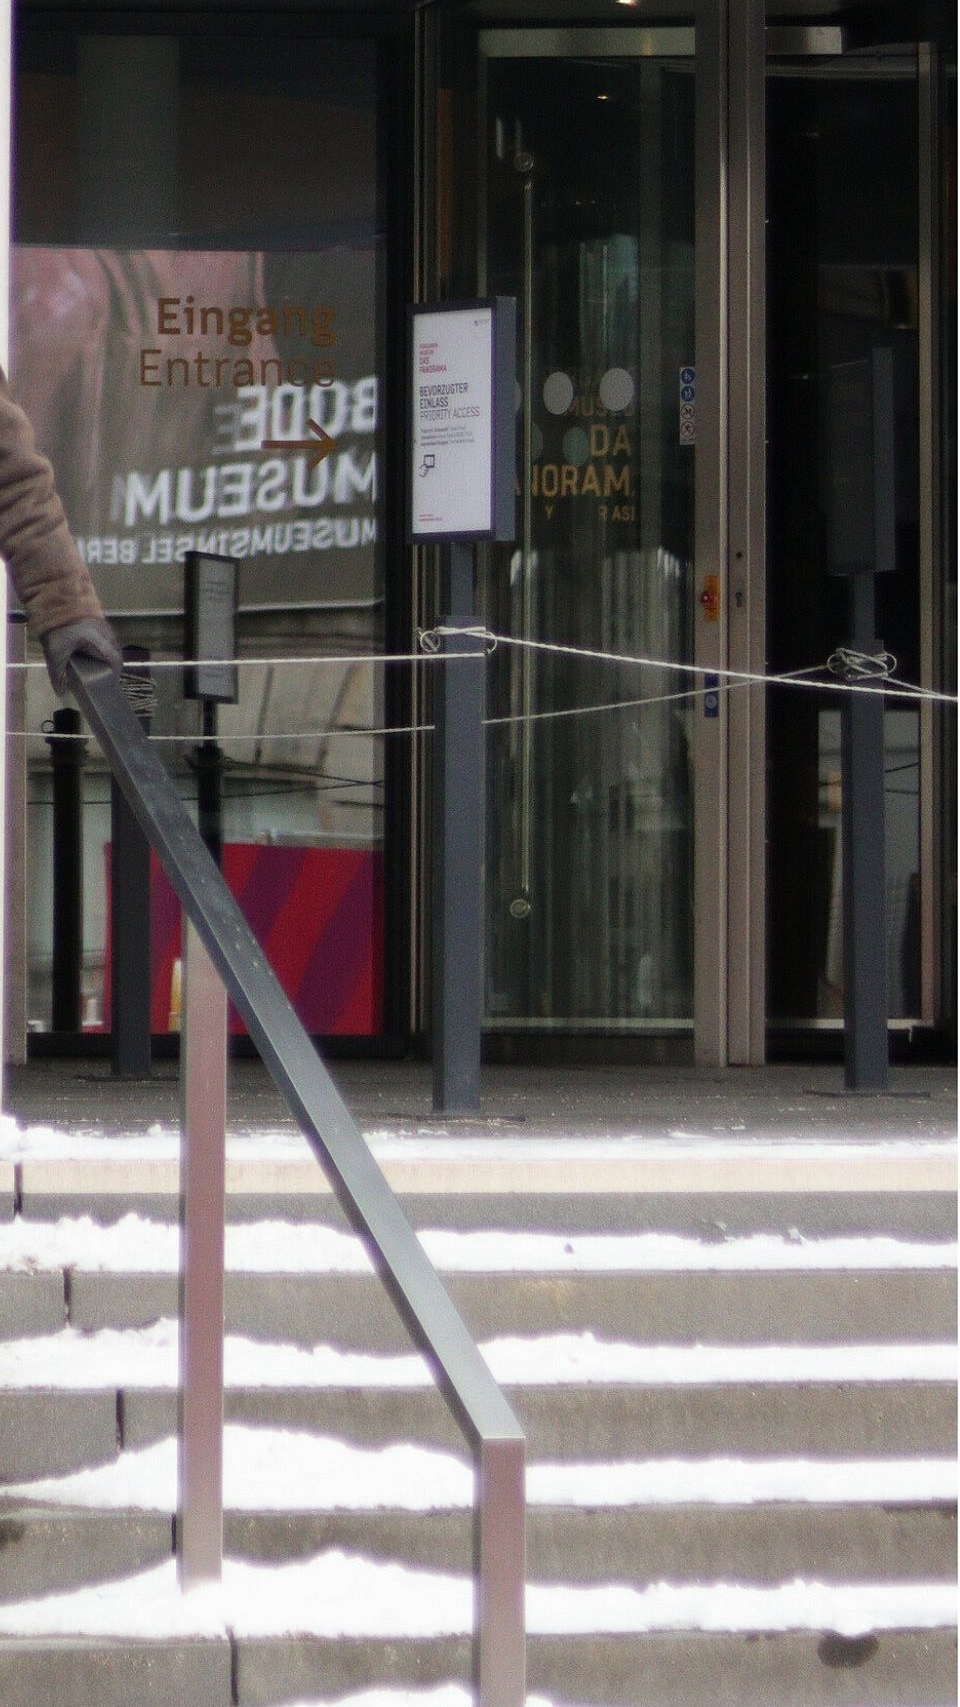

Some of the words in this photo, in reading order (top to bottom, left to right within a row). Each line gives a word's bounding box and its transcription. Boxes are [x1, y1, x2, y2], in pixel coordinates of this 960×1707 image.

[157, 296, 337, 346] Eingang
[140, 349, 337, 387] Entrance
[419, 382, 469, 397] BEVORZUGTER
[419, 397, 449, 410] EINLASS
